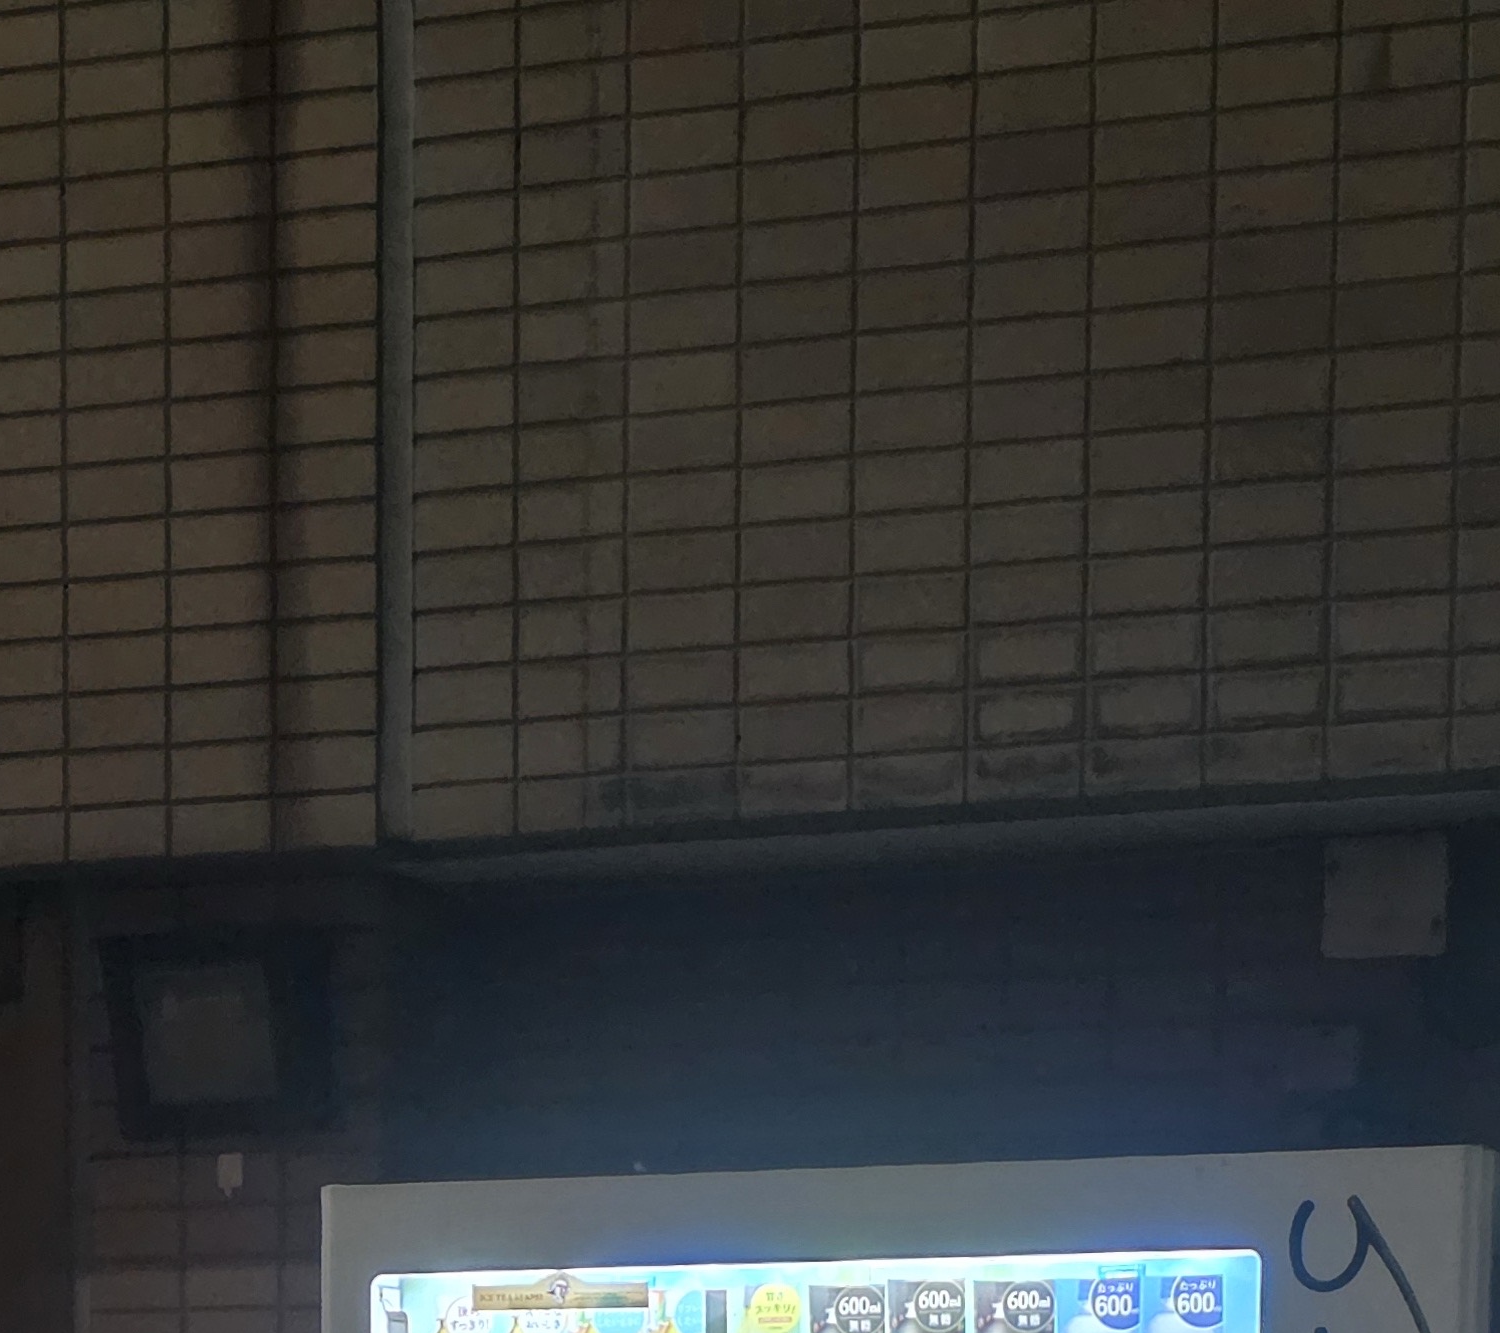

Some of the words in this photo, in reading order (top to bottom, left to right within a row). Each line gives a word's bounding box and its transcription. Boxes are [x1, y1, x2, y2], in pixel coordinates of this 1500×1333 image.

[1097, 1282, 1133, 1293] たっぷり
[1180, 1281, 1216, 1290] たっぷり
